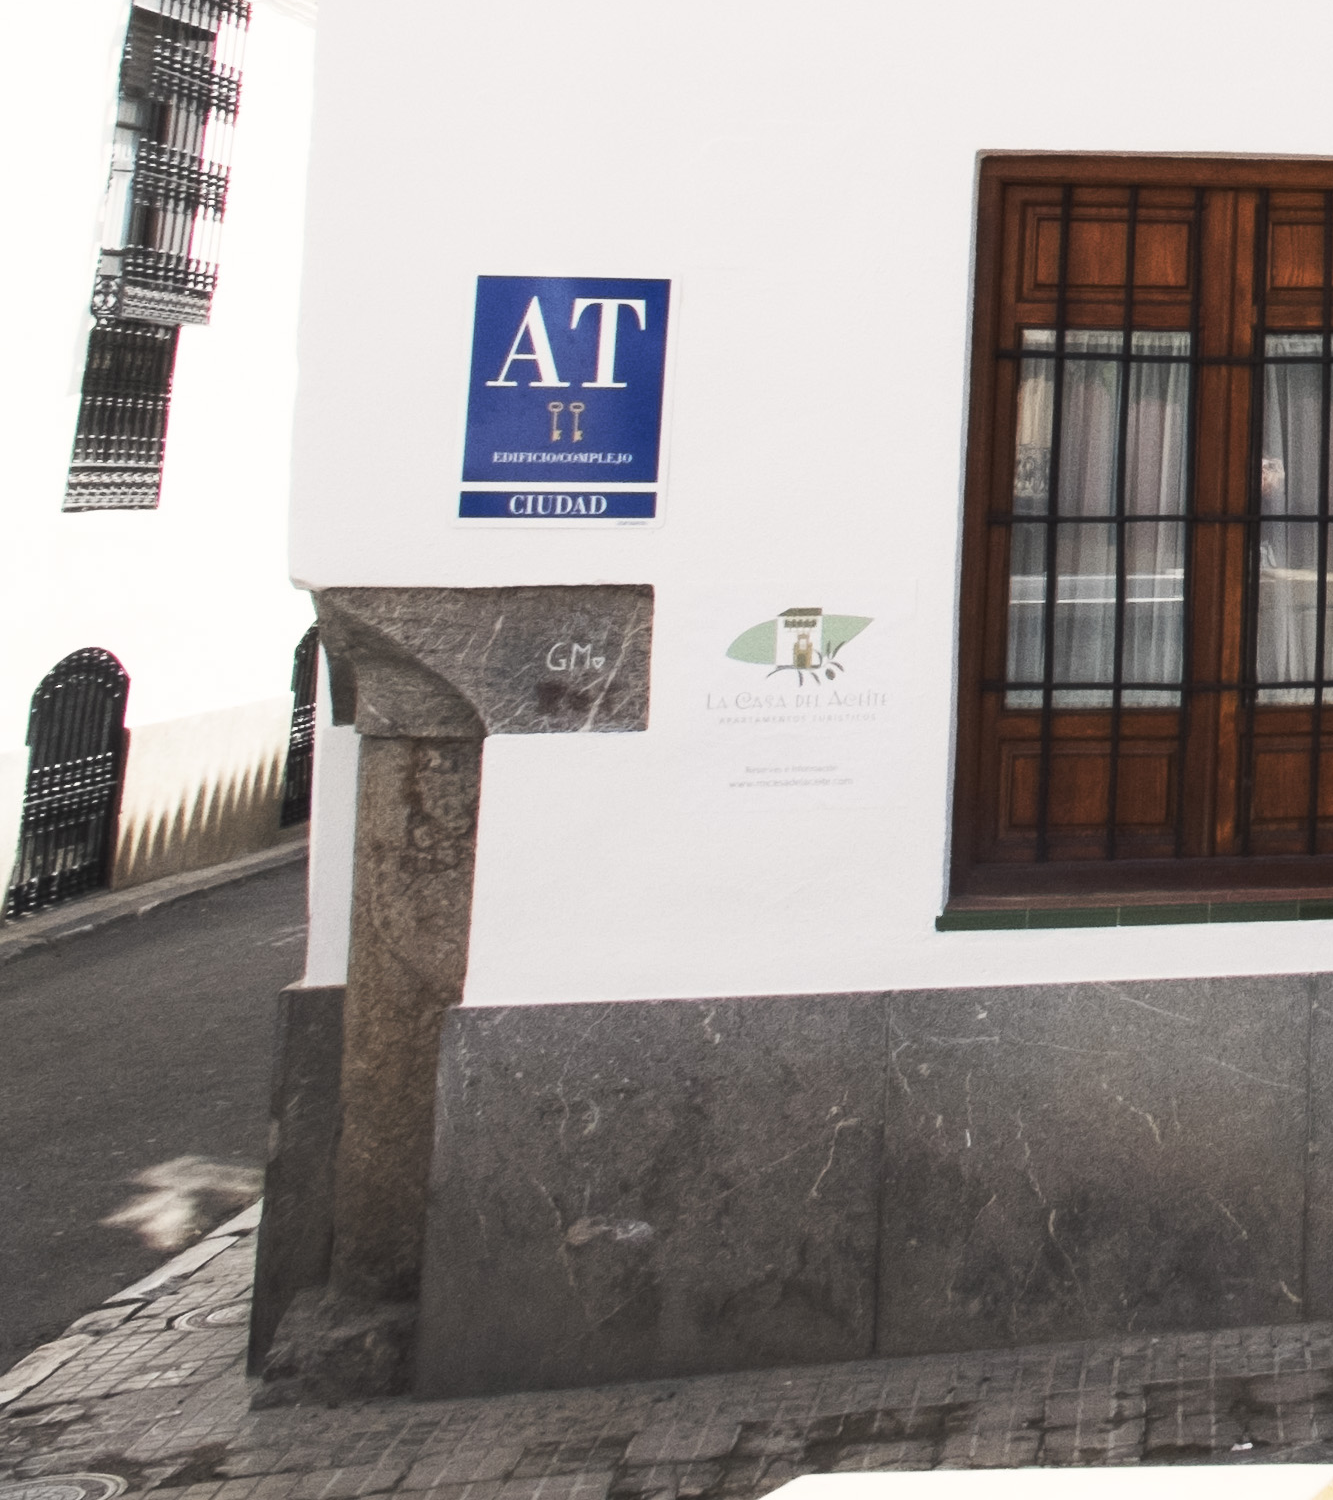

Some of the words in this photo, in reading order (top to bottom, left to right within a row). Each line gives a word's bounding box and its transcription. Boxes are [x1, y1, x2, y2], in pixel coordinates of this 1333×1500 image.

[485, 295, 646, 388] AT
[509, 495, 607, 515] CIUDAD
[706, 692, 728, 710] LA
[735, 691, 787, 710] CASA
